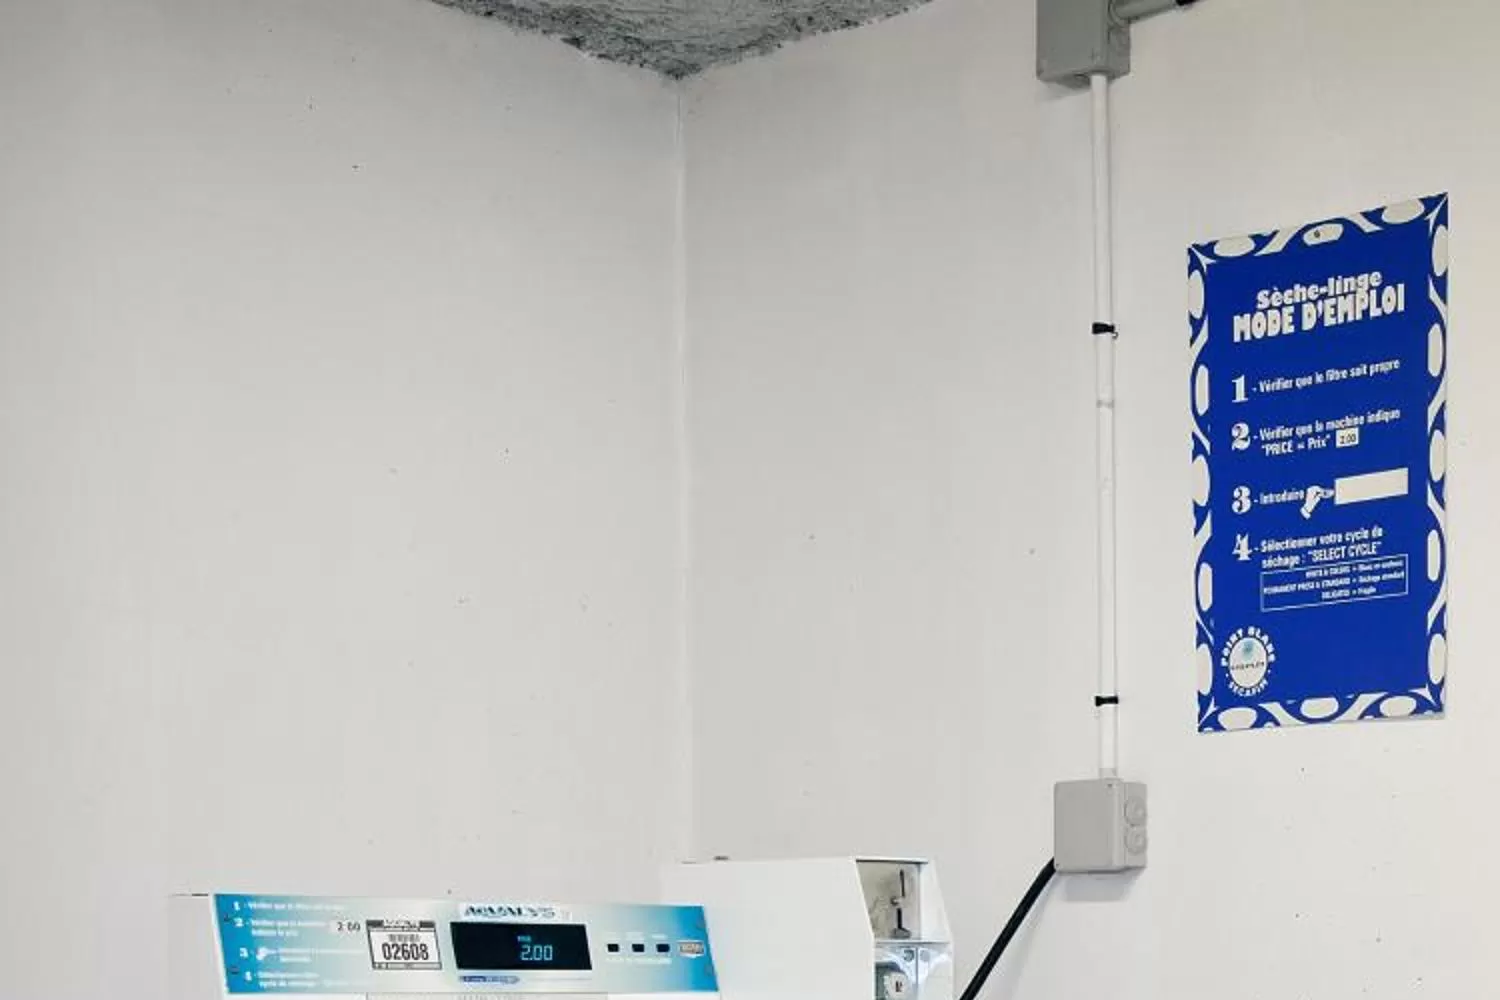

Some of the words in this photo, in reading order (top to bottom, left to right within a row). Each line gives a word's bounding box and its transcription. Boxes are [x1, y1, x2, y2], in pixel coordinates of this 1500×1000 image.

[1256, 271, 1382, 310] Sèche-linge
[1233, 303, 1295, 343] MODE
[1302, 284, 1405, 331] D'EMPLOI
[1232, 374, 1248, 403] 1
[1259, 378, 1293, 393] Vérifier
[1295, 375, 1313, 389] que
[1315, 371, 1324, 384] le
[1326, 369, 1348, 381] filtre
[1350, 365, 1367, 378] soit
[1369, 359, 1400, 376] propre
[1231, 422, 1250, 451] 2
[1259, 426, 1293, 441] Vérifier
[1295, 424, 1313, 437] que
[1315, 420, 1324, 433] la
[1326, 414, 1365, 429] machine
[1367, 408, 1401, 423] indique
[1232, 485, 1251, 514] 3
[1260, 489, 1304, 505] Introduire
[1232, 534, 1252, 561] 4
[1261, 536, 1317, 553] Sélectionner
[1319, 533, 1343, 545] votre
[1345, 529, 1369, 542] cycle
[1371, 525, 1383, 537] de
[381, 943, 429, 961] 02608
[520, 945, 553, 961] 2.00
